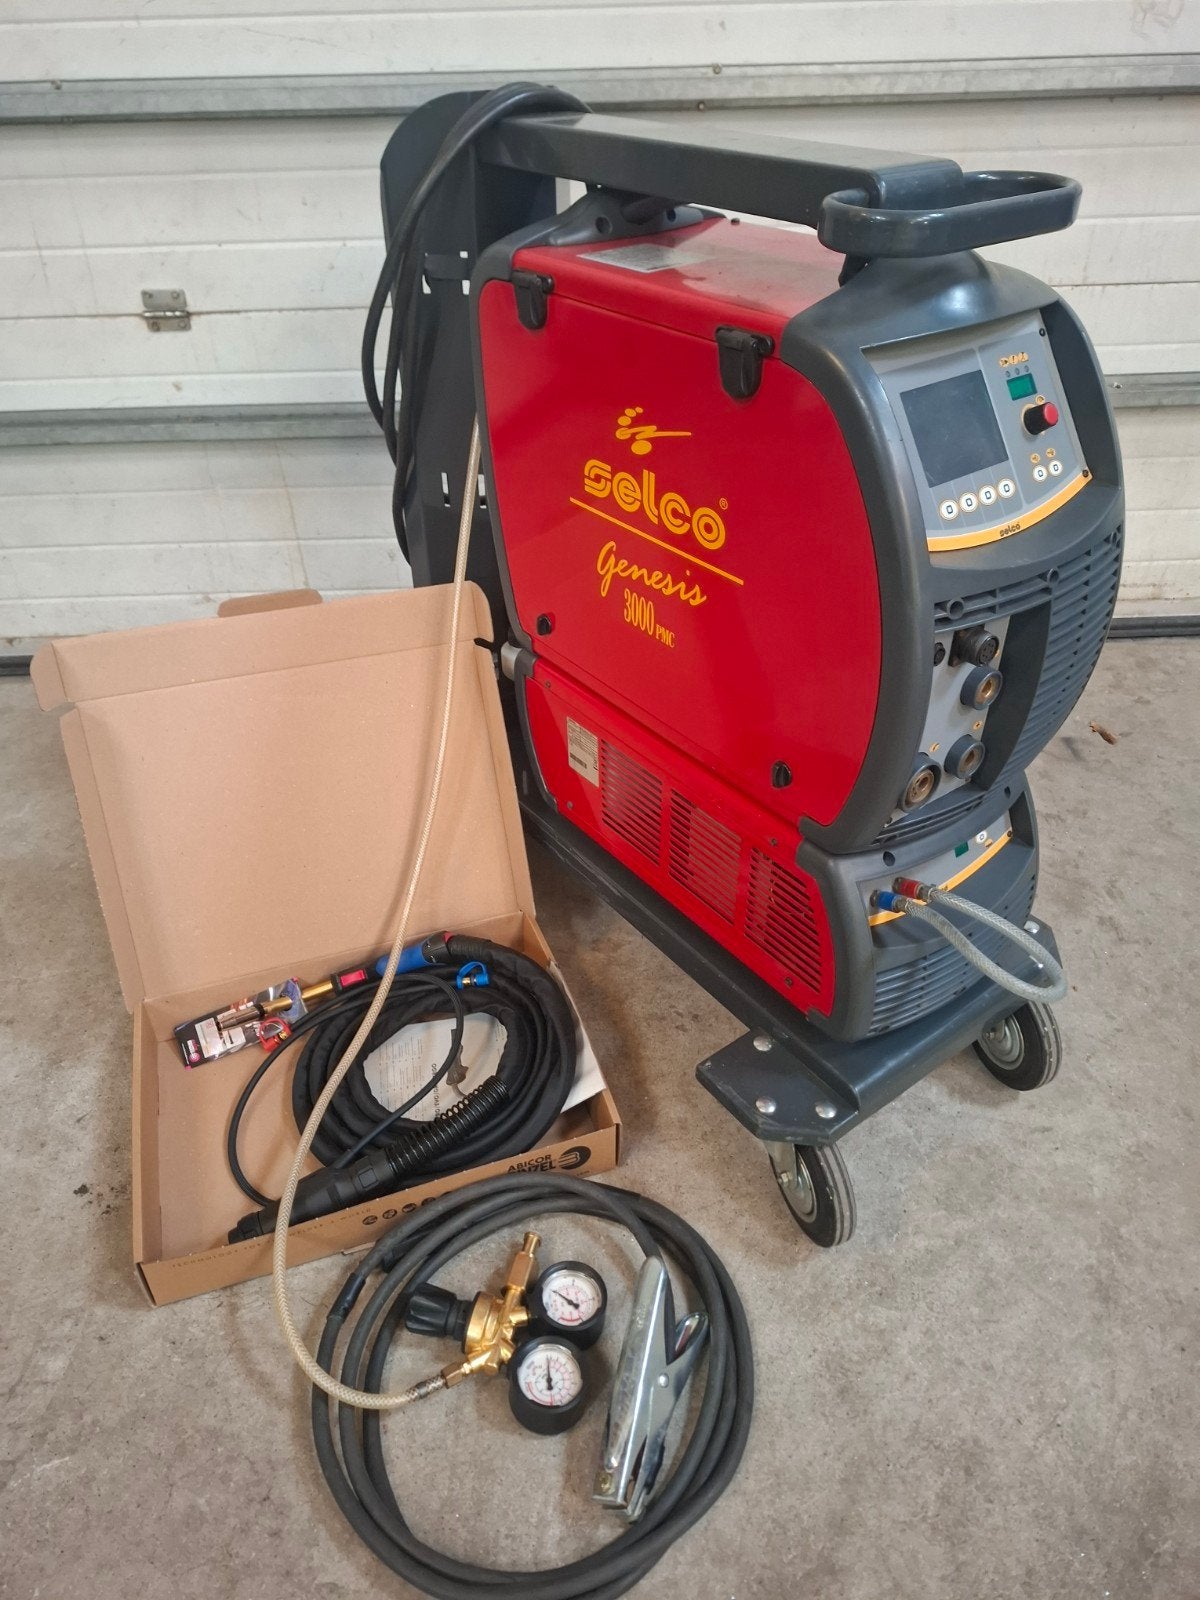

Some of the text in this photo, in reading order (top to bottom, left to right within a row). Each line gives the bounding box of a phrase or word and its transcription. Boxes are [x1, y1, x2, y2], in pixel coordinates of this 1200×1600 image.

[584, 459, 726, 550] selco
[999, 523, 1021, 537] selco
[597, 541, 707, 606] Genesis
[624, 588, 676, 648] 3000 PMC
[508, 1154, 552, 1172] ABICOR
